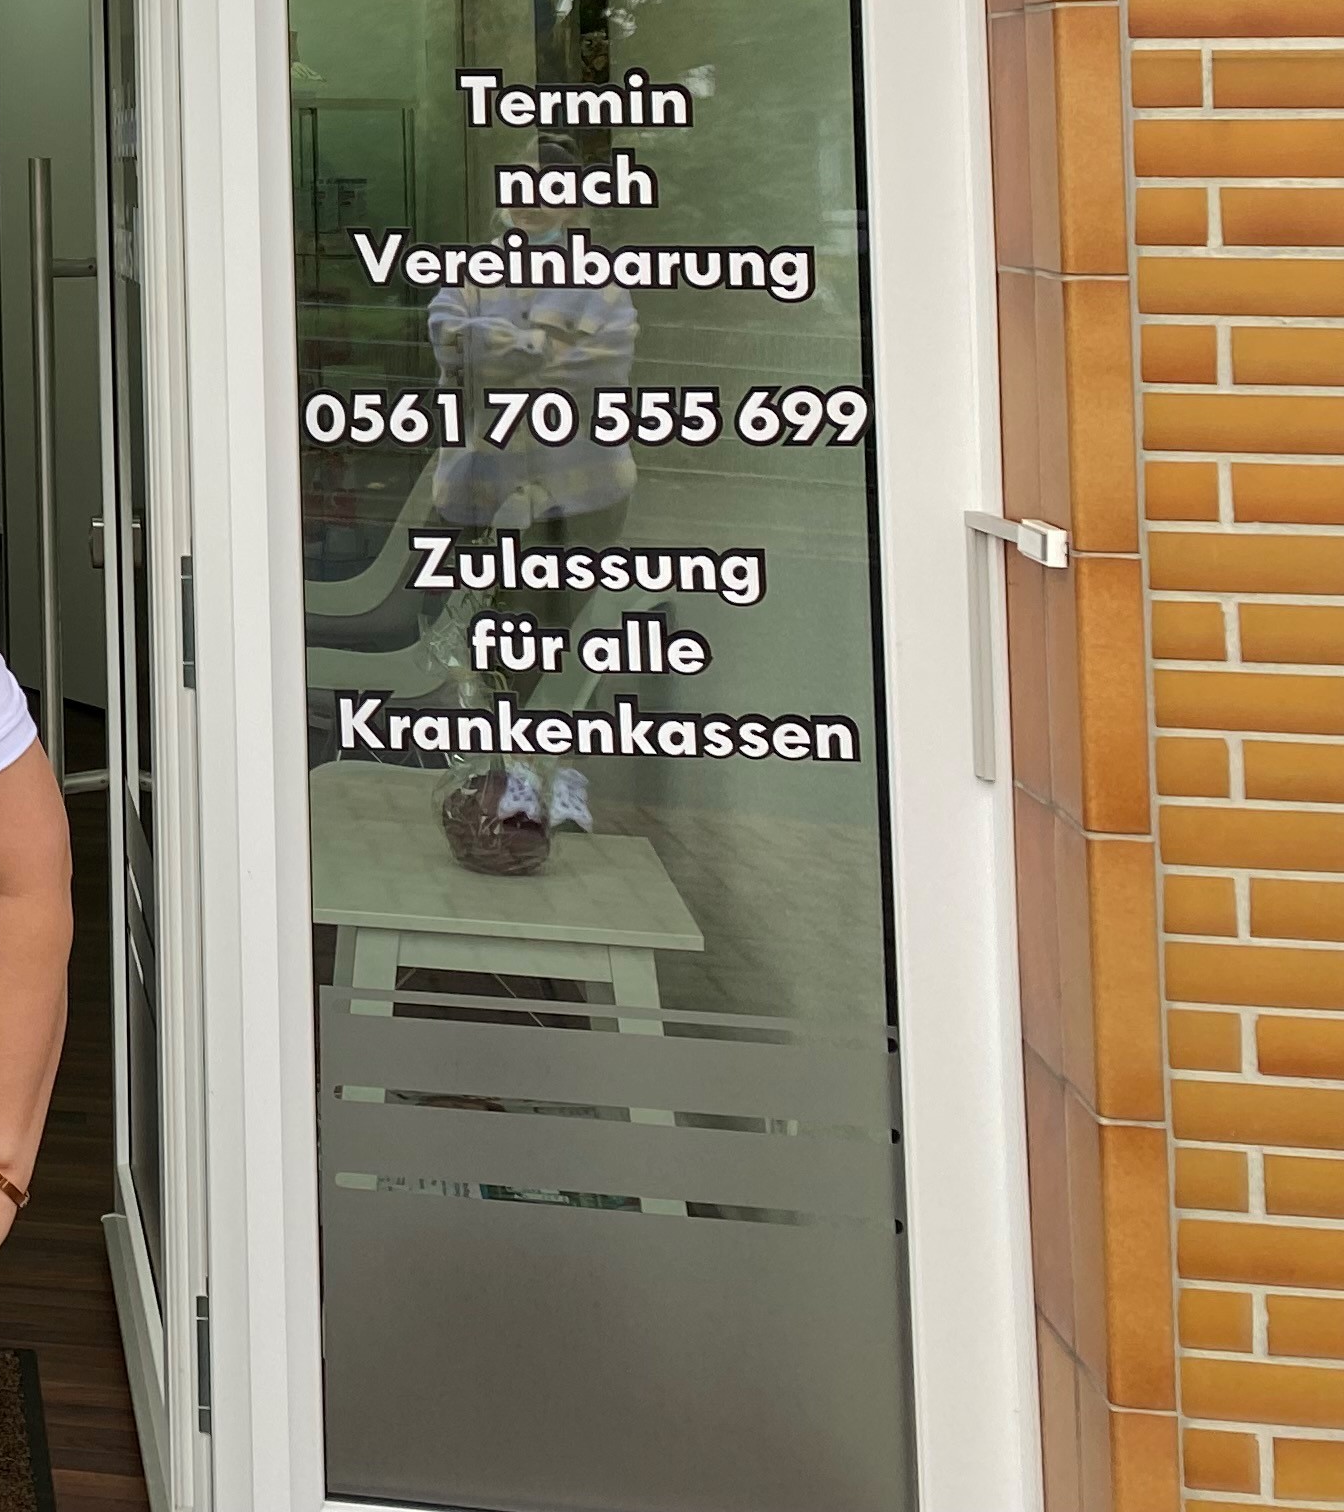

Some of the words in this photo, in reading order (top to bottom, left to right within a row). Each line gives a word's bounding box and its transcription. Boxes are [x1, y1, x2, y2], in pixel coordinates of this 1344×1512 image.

[457, 71, 691, 129] Termin
[495, 151, 656, 209] nach
[351, 230, 813, 303] Vereinbarung
[301, 390, 464, 446] 0561
[484, 389, 577, 447] 70
[591, 389, 720, 447] 555
[735, 387, 872, 446] 699
[410, 533, 765, 607] Zulassung
[468, 615, 568, 675] für
[578, 617, 709, 677] alle
[336, 695, 858, 763] Krankenkassen
